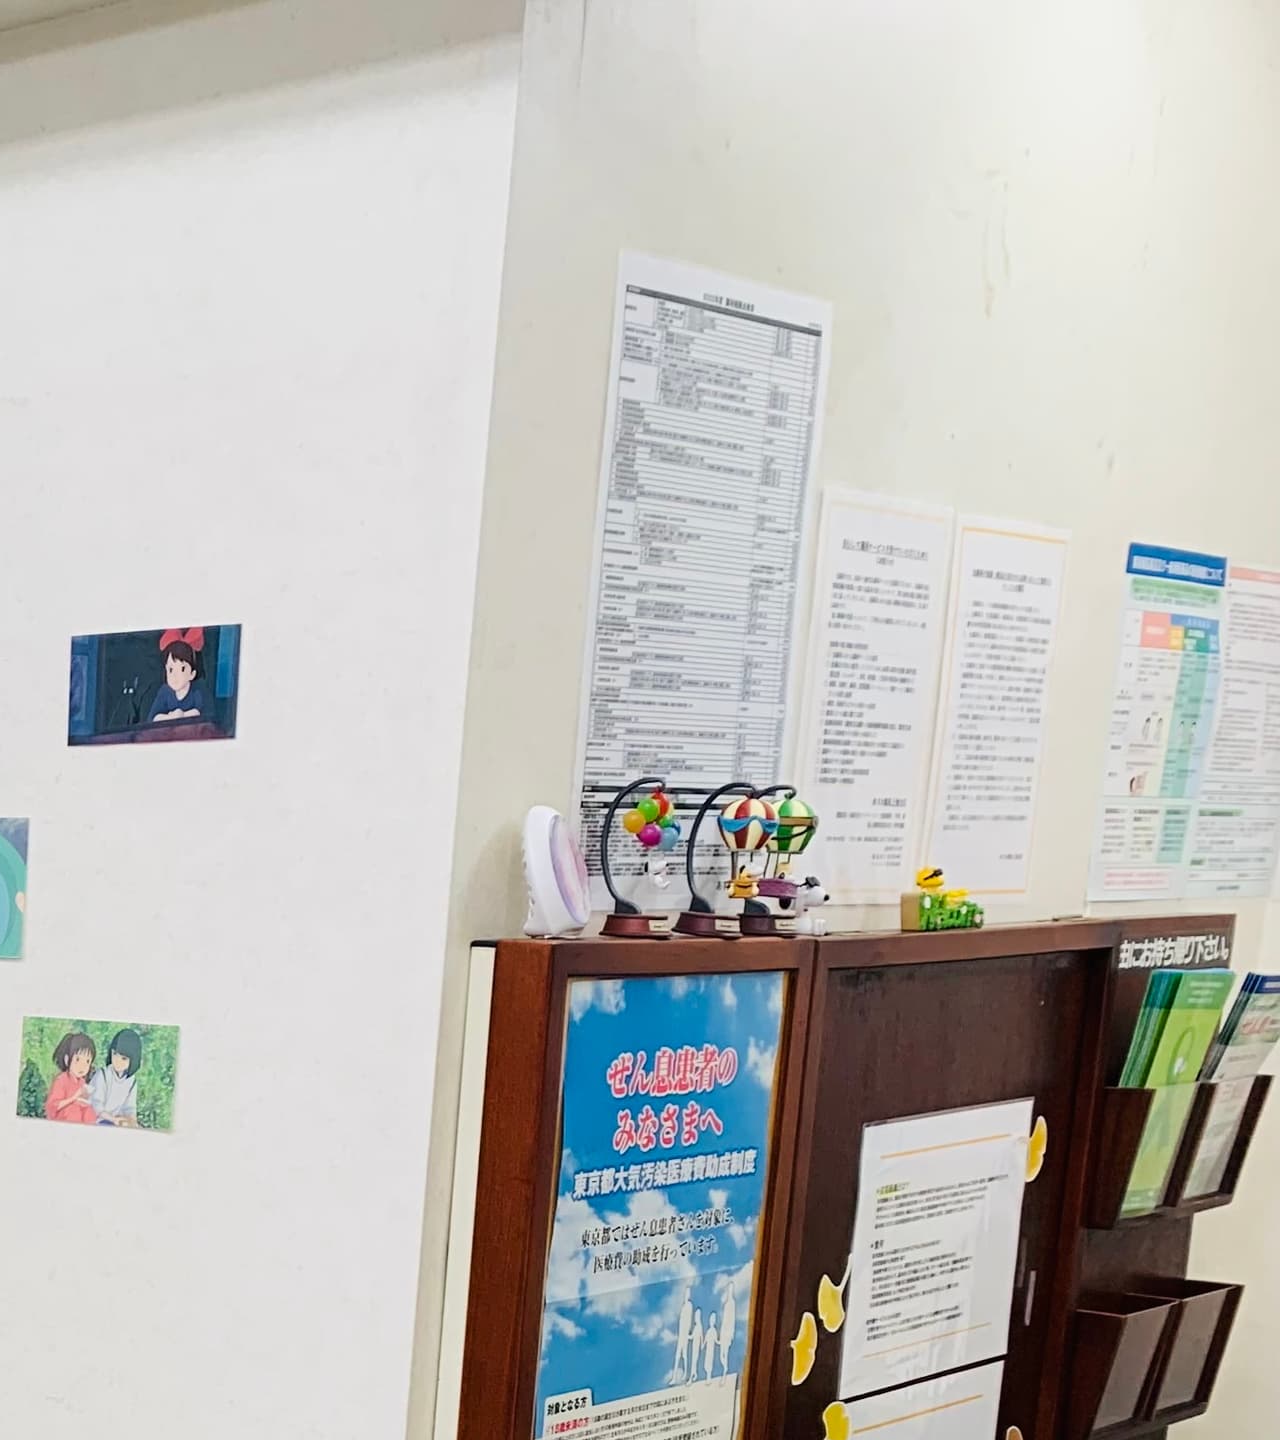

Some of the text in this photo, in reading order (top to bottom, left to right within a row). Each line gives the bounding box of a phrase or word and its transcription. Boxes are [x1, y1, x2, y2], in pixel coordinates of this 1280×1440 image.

[607, 1045, 738, 1098] ぜん息患者の
[613, 1101, 723, 1153] みなさまへ
[573, 1151, 758, 1200] 東京都大気汚染医療費助成制度
[547, 1396, 588, 1416] 対象となる方
